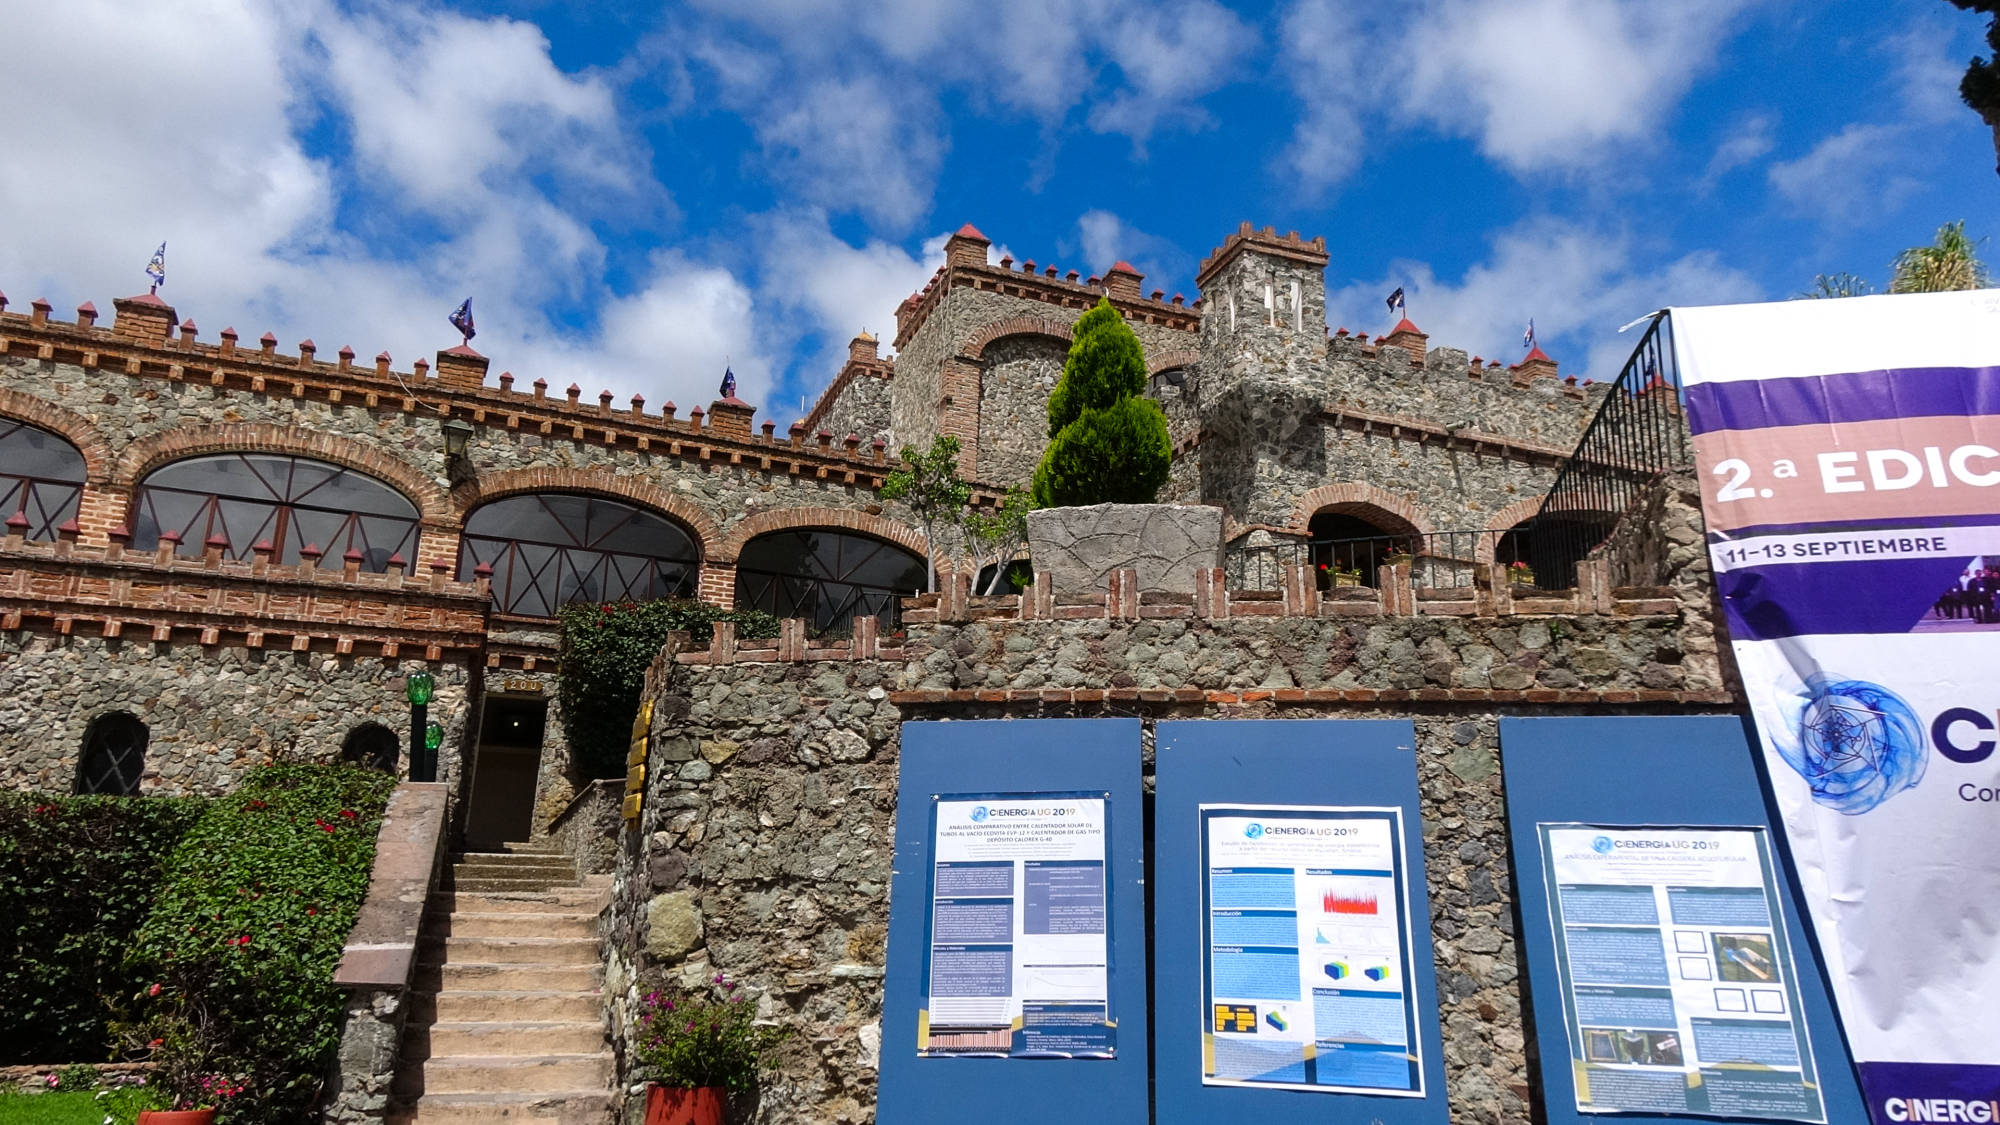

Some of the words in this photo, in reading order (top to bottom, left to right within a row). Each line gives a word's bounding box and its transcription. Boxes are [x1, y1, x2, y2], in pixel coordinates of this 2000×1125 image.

[1817, 444, 2000, 494] EDIC
[1793, 537, 1948, 557] SEPTIEMBRE
[1931, 707, 2000, 764] C
[1037, 808, 1051, 816] UG
[1052, 808, 1076, 816] 2019
[1317, 827, 1331, 836] UG
[1334, 827, 1359, 837] 2019
[1672, 840, 1690, 849] UG
[1692, 840, 1720, 850] 2019
